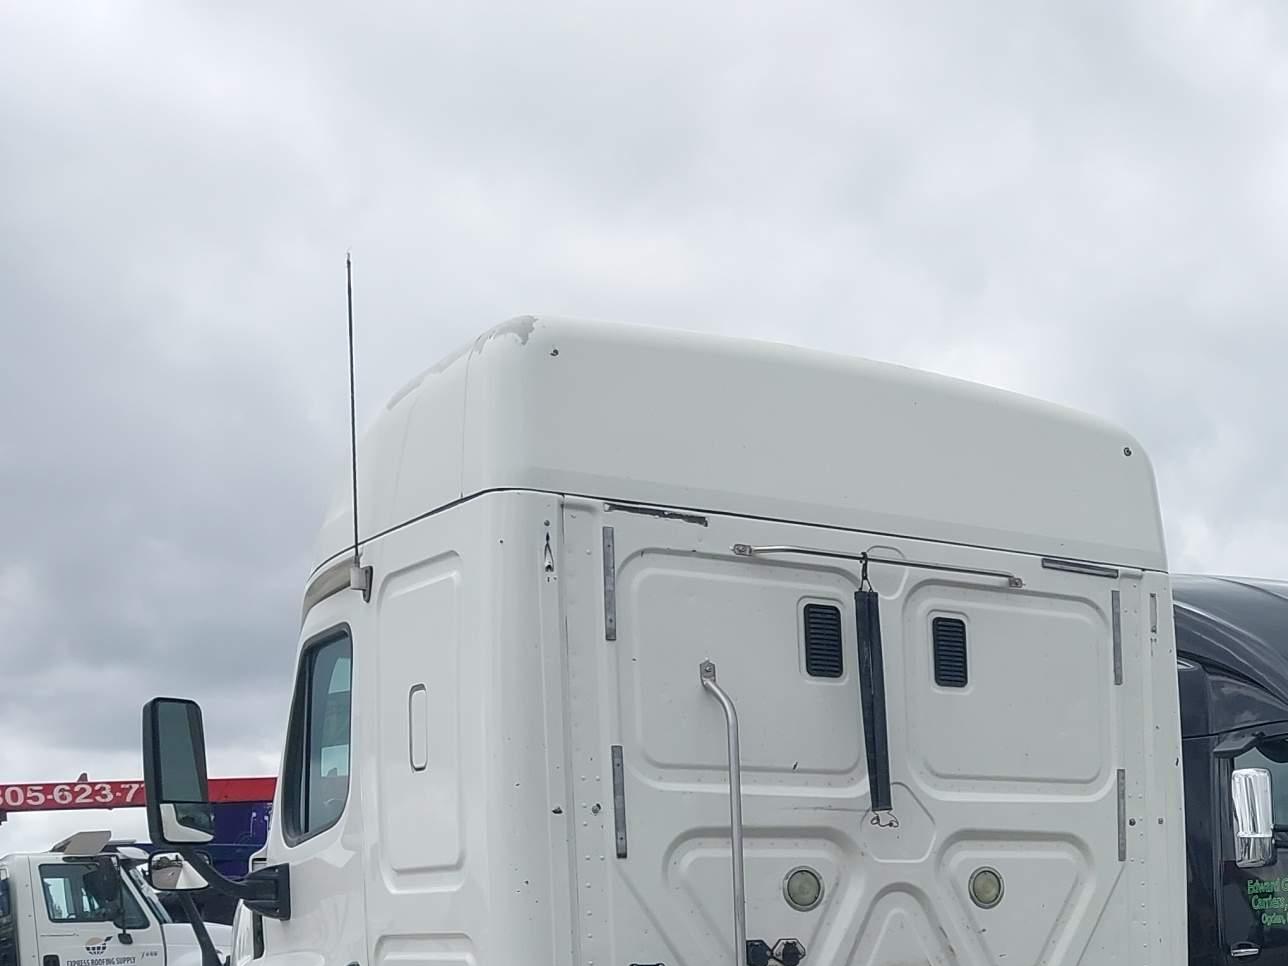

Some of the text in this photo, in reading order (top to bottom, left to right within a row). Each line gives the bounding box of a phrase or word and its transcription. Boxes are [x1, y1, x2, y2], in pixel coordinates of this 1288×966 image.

[0, 784, 144, 806] 05-623-7
[1248, 879, 1280, 894] Edward
[91, 958, 115, 966] ROOFING
[116, 957, 136, 965] SUPPLY
